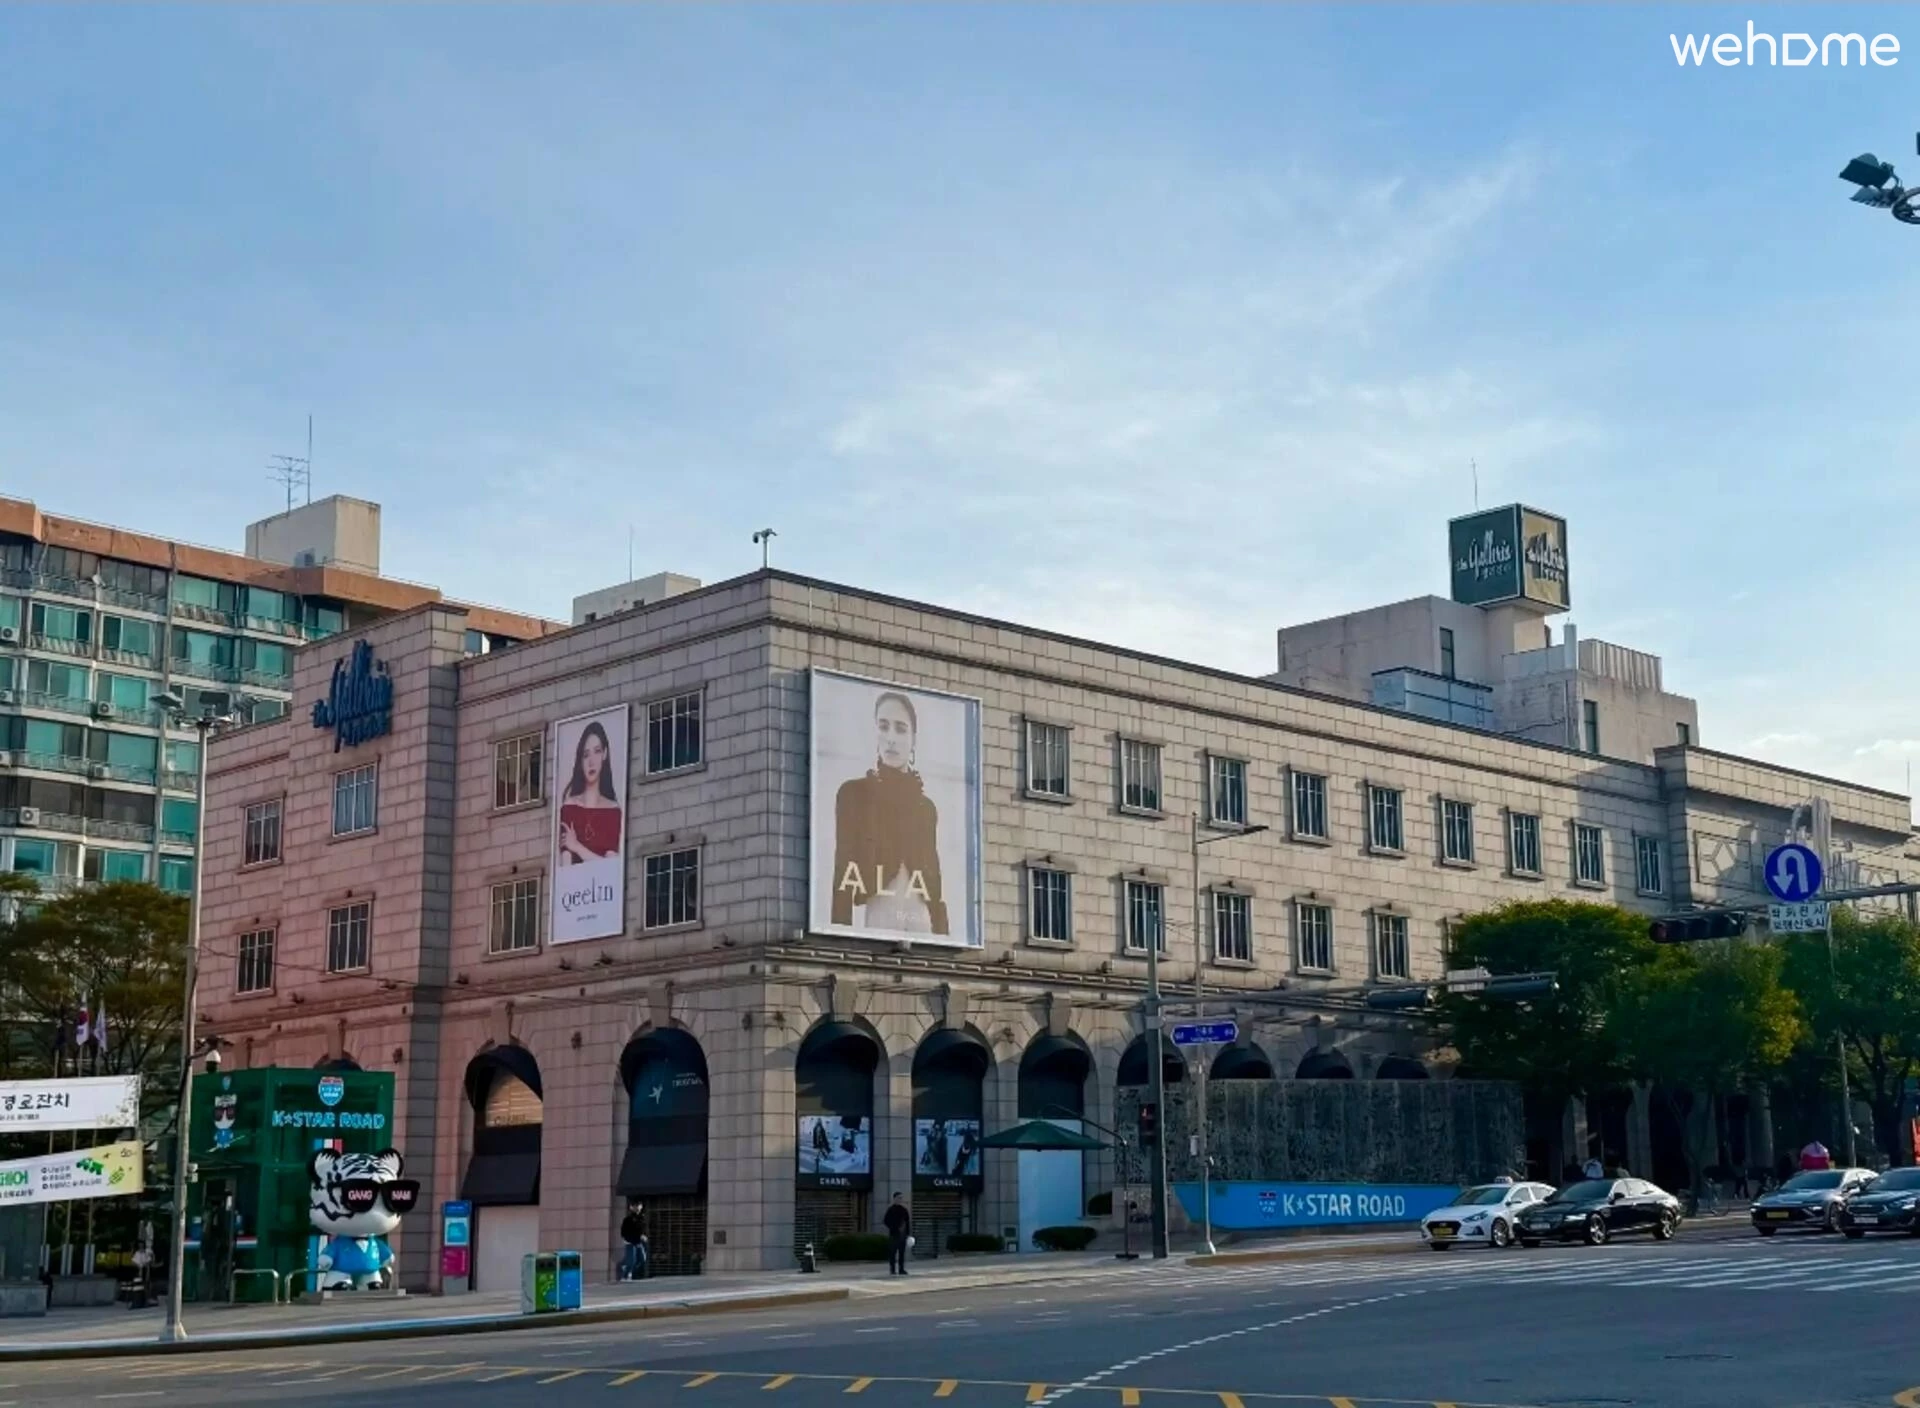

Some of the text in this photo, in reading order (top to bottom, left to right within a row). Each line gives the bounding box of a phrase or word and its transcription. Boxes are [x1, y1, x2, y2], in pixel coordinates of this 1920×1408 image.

[1, 1092, 70, 1112] 경로잔치
[339, 1111, 385, 1129] ROAD
[1357, 1194, 1406, 1217] ROAD
